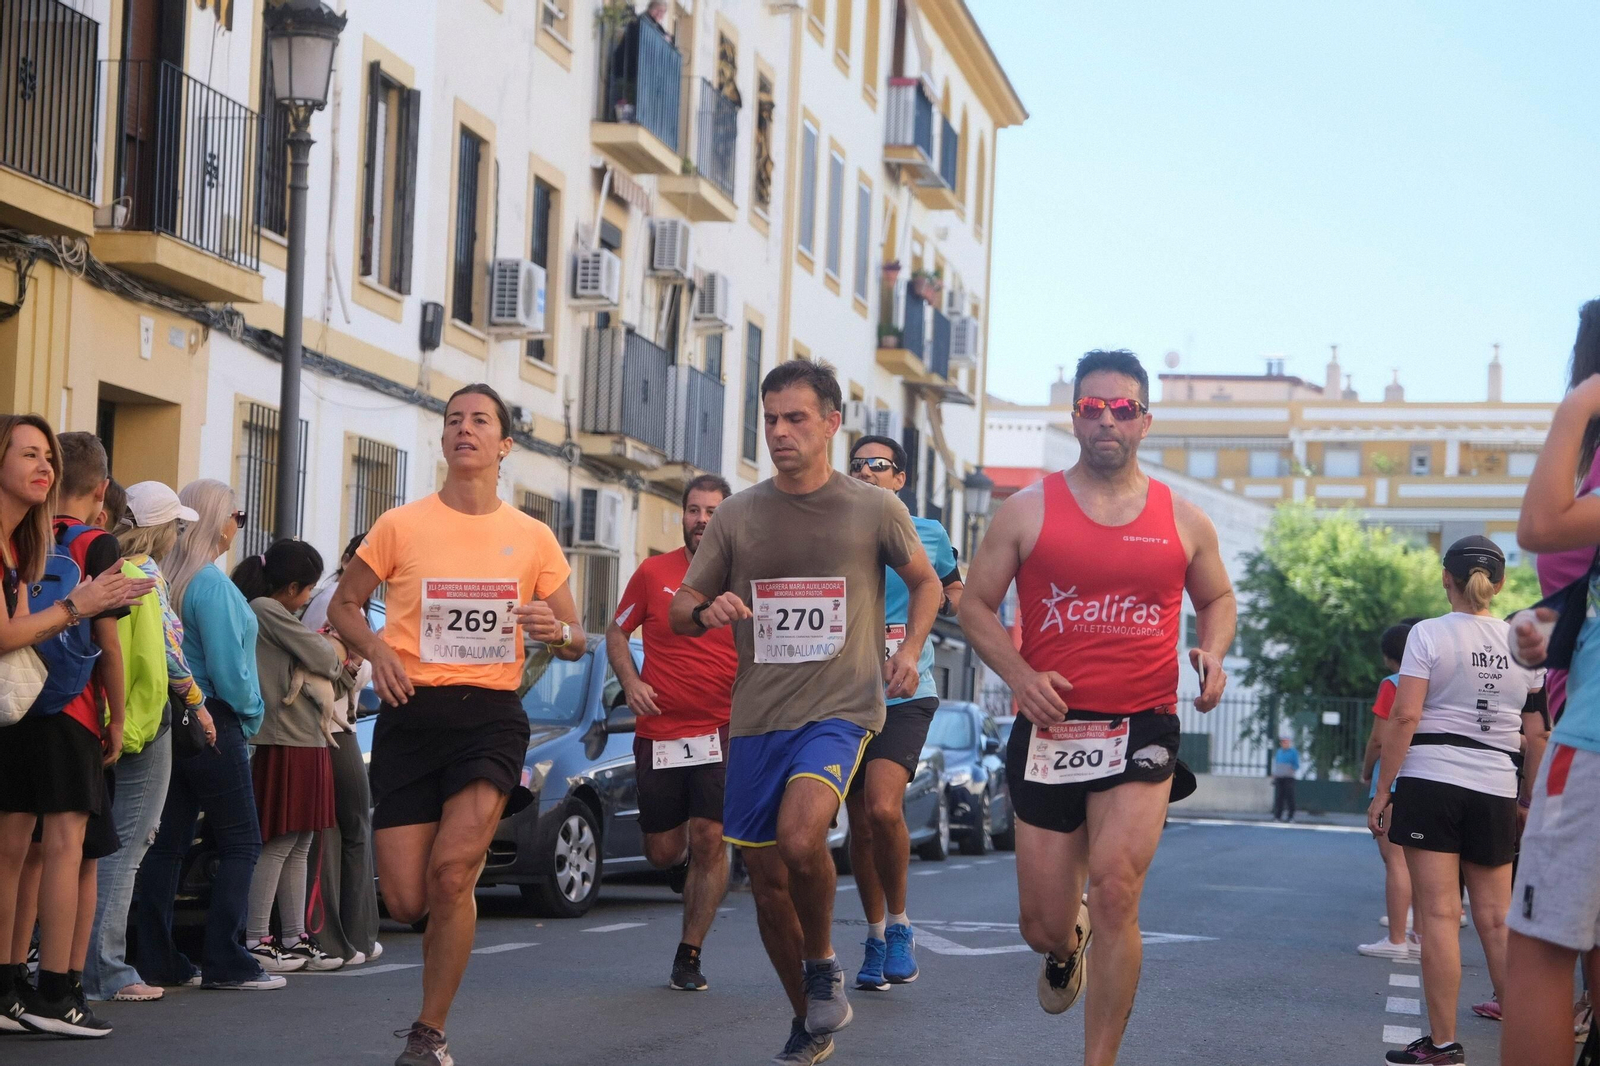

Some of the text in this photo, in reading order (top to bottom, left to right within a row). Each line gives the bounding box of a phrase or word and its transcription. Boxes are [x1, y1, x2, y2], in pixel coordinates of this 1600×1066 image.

[447, 591, 468, 599] MEMORIAL
[470, 591, 480, 599] KIKO
[775, 590, 795, 598] MEMORIAL
[796, 590, 806, 598] KIKO
[1067, 595, 1160, 625] califas
[447, 609, 497, 632] 269
[777, 609, 823, 630] 270
[1478, 672, 1502, 680] COVAP
[683, 743, 693, 758] 1
